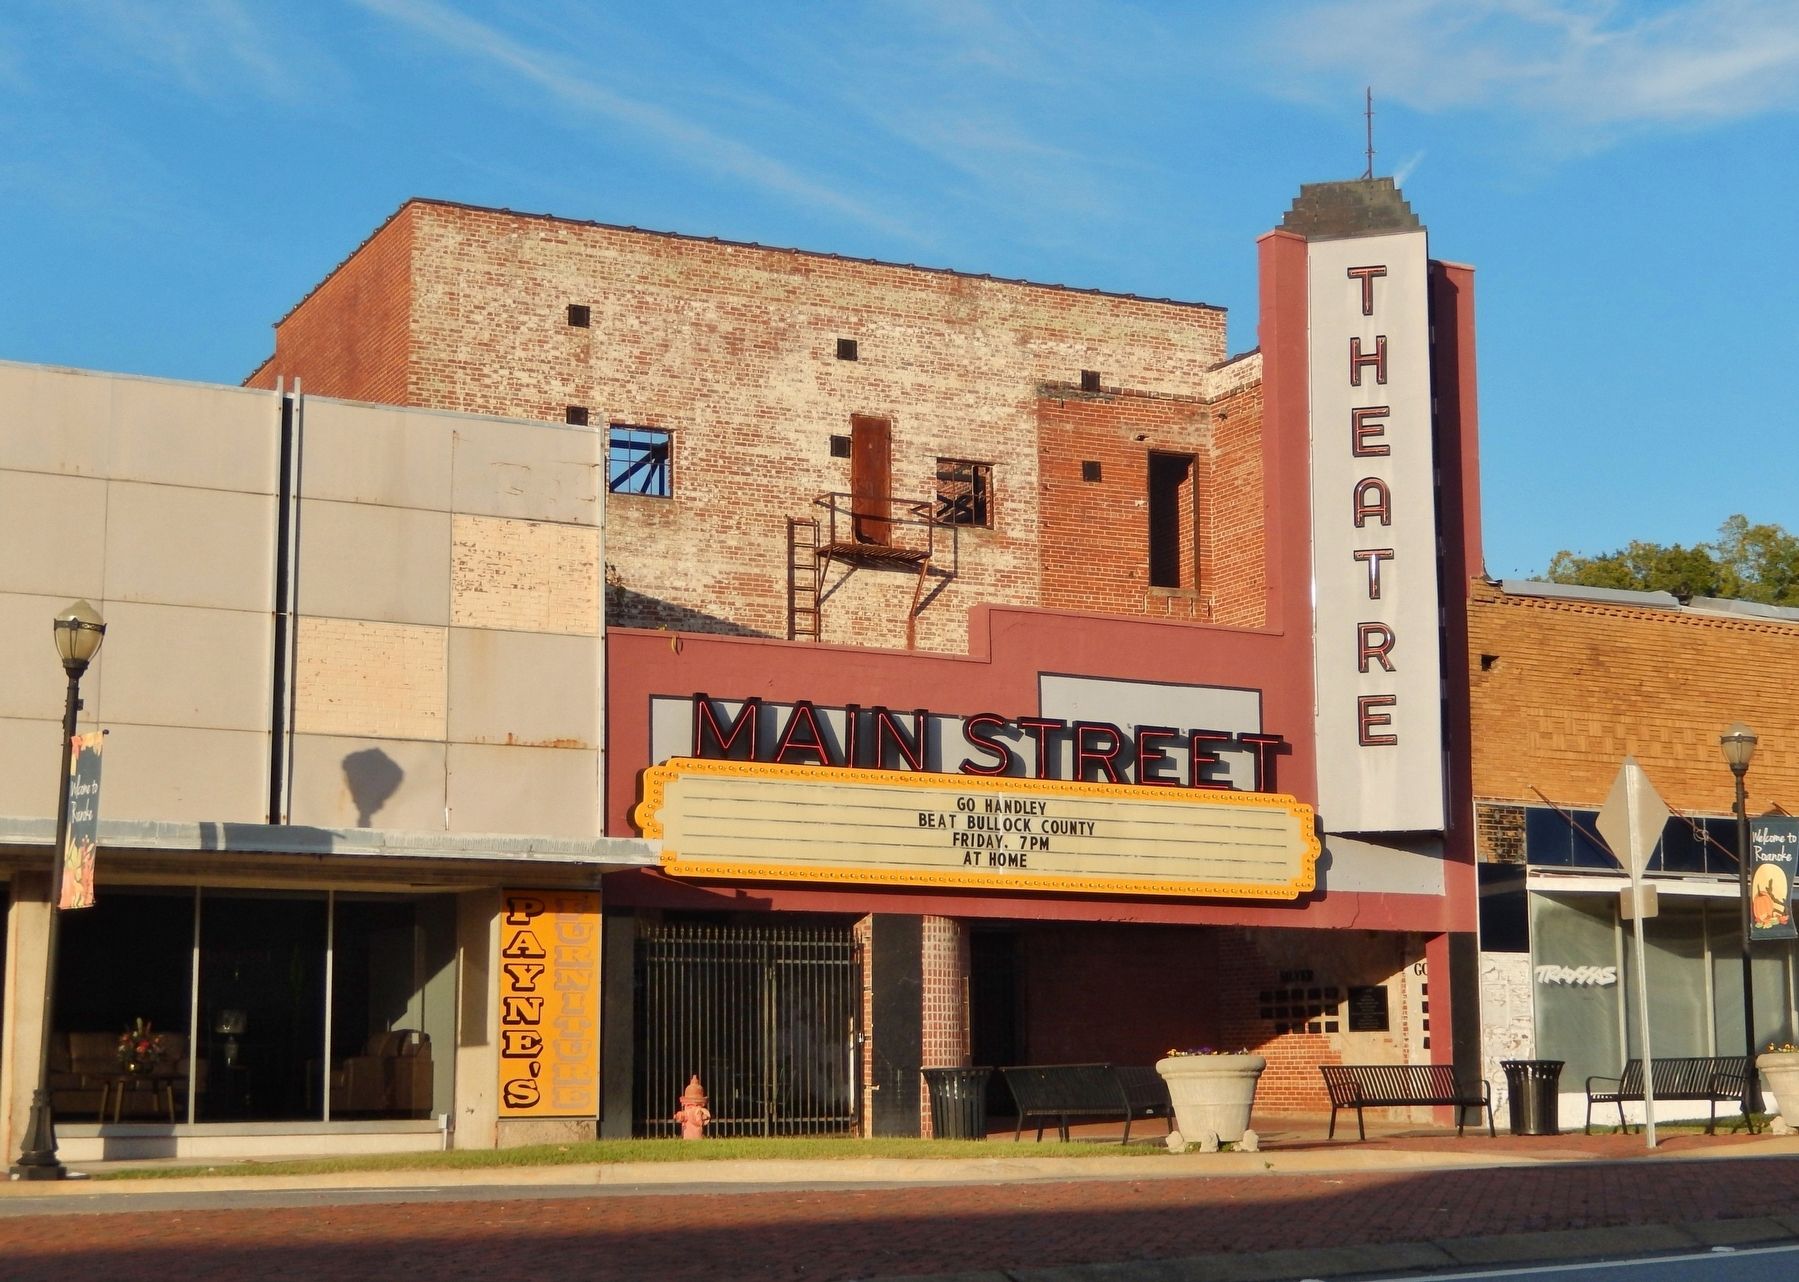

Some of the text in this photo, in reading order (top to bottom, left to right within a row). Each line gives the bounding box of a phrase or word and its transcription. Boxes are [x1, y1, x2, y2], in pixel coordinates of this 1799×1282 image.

[1347, 265, 1398, 747] THEATRE
[691, 692, 1286, 793] MAIN STREET
[956, 797, 1047, 816] GO HANDLEY
[918, 812, 1095, 836] BEAT BULLOCK COUNTY
[1019, 836, 1050, 851] 7PM
[1752, 827, 1797, 845] Welcome to
[963, 851, 1028, 868] AT HOME
[1753, 845, 1792, 862] Roanoke
[502, 896, 547, 1109] PAYNE'S
